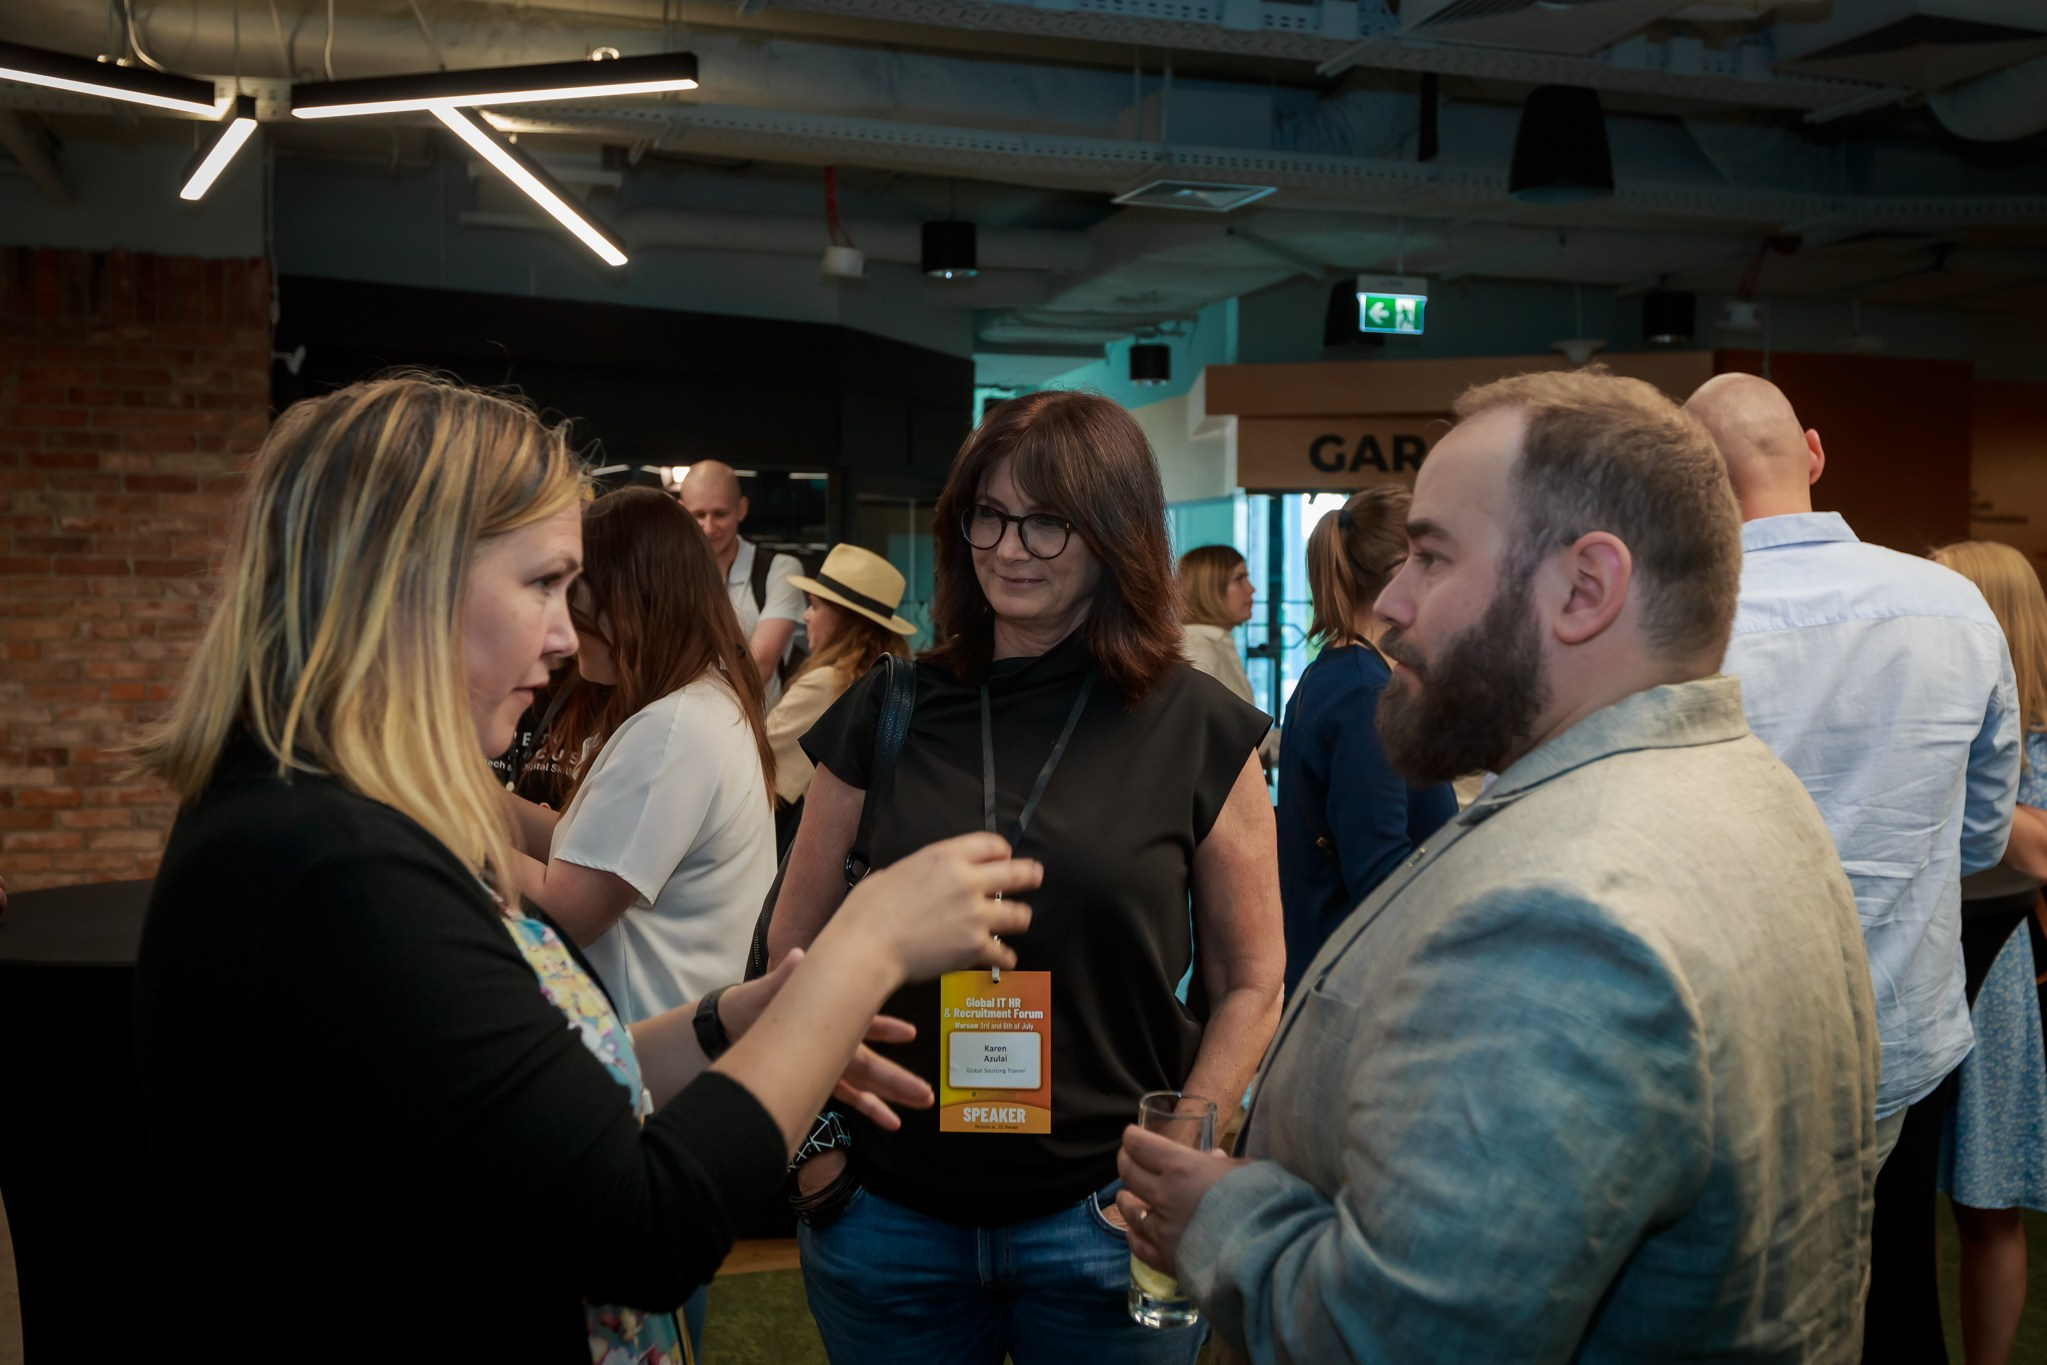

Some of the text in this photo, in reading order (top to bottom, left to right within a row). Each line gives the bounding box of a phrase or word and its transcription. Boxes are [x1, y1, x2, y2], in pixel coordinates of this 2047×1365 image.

[966, 997, 1021, 1008] Global IT HR
[944, 1008, 1044, 1019] & Recruitment Forum
[1021, 1022, 1034, 1031] July
[984, 1044, 1007, 1052] Karen
[963, 1107, 1026, 1123] SPEAKER
